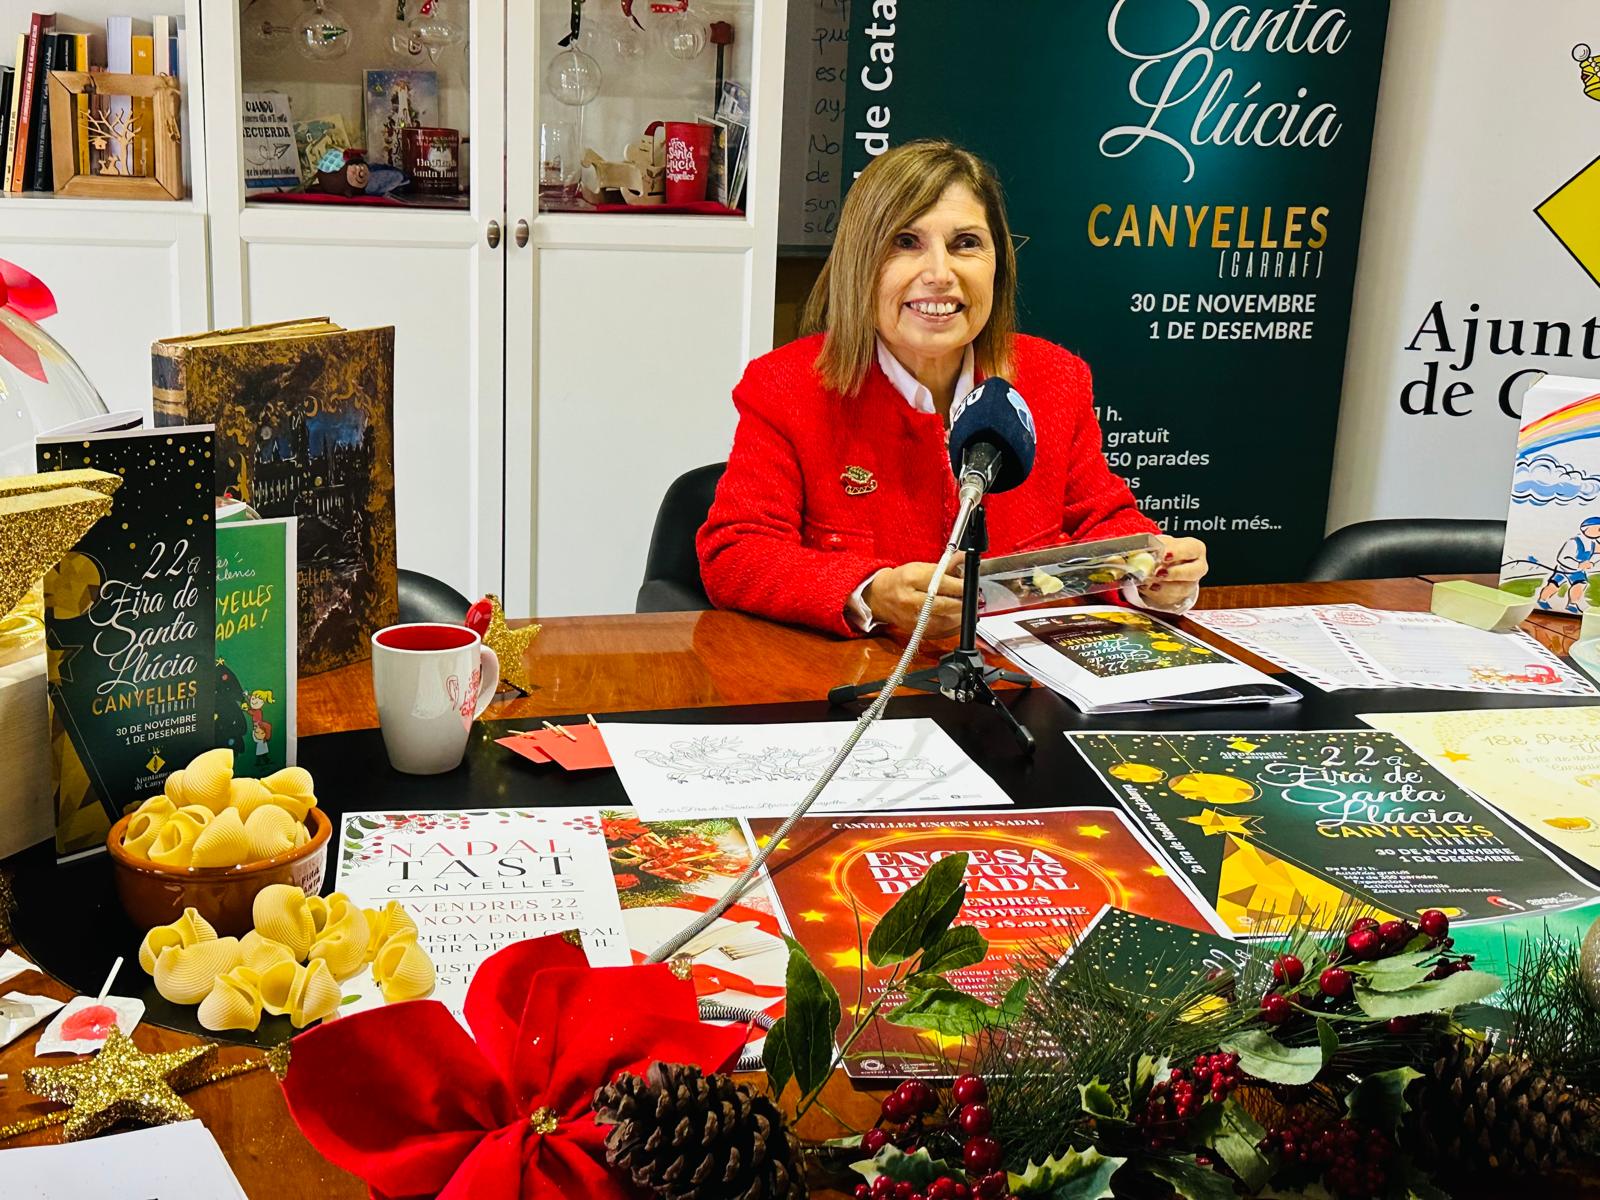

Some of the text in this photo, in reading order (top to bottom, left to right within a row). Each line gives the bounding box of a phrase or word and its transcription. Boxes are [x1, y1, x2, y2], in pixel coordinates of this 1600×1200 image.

[1107, 0, 1353, 61] Santa
[1098, 46, 1343, 184] Llúcia
[855, 106, 890, 156] de
[1087, 204, 1331, 250] CANYELLES
[1130, 293, 1317, 314] 30 DE NOVEMBRE
[1149, 321, 1313, 340] 1 DE DESEMBRE
[1400, 361, 1475, 418] de
[1107, 406, 1123, 422] h.
[1108, 428, 1169, 448] gratuït
[1137, 450, 1210, 474] parades
[1136, 493, 1200, 510] nfantils
[1174, 516, 1179, 531] i
[1184, 515, 1226, 531] molt
[1232, 515, 1283, 531] més...
[87, 575, 199, 628] Fira de
[92, 609, 199, 657] Santa
[216, 608, 268, 640] ADAL!
[97, 642, 198, 695] Llúcia
[92, 680, 198, 716] CANYELLES
[116, 713, 197, 737] 30 DE NOVEMBRE
[126, 723, 197, 745] 1 DE DESEMBRE
[1256, 762, 1424, 788] Fira de
[1281, 778, 1446, 806] Santa
[832, 818, 1045, 831] CANYELLES ENCEN EL NADAL
[1315, 800, 1473, 830] Llúcia
[1151, 822, 1178, 841] Nadal
[1316, 825, 1495, 839] CANYELLES
[390, 839, 571, 859] NADAL
[1170, 841, 1186, 851] de
[1375, 847, 1516, 856] 30 DE NOVEMBRE
[388, 856, 574, 881] TAST
[1399, 854, 1524, 863] 1 DE DESEMBRE
[869, 865, 1069, 883] DE LUMS
[387, 879, 575, 894] CANYELLES
[379, 897, 579, 915] VENDRES 22
[963, 906, 1091, 918] NOVEMBRE
[424, 910, 585, 926] NOVEMBRE
[489, 929, 528, 941] DEL
